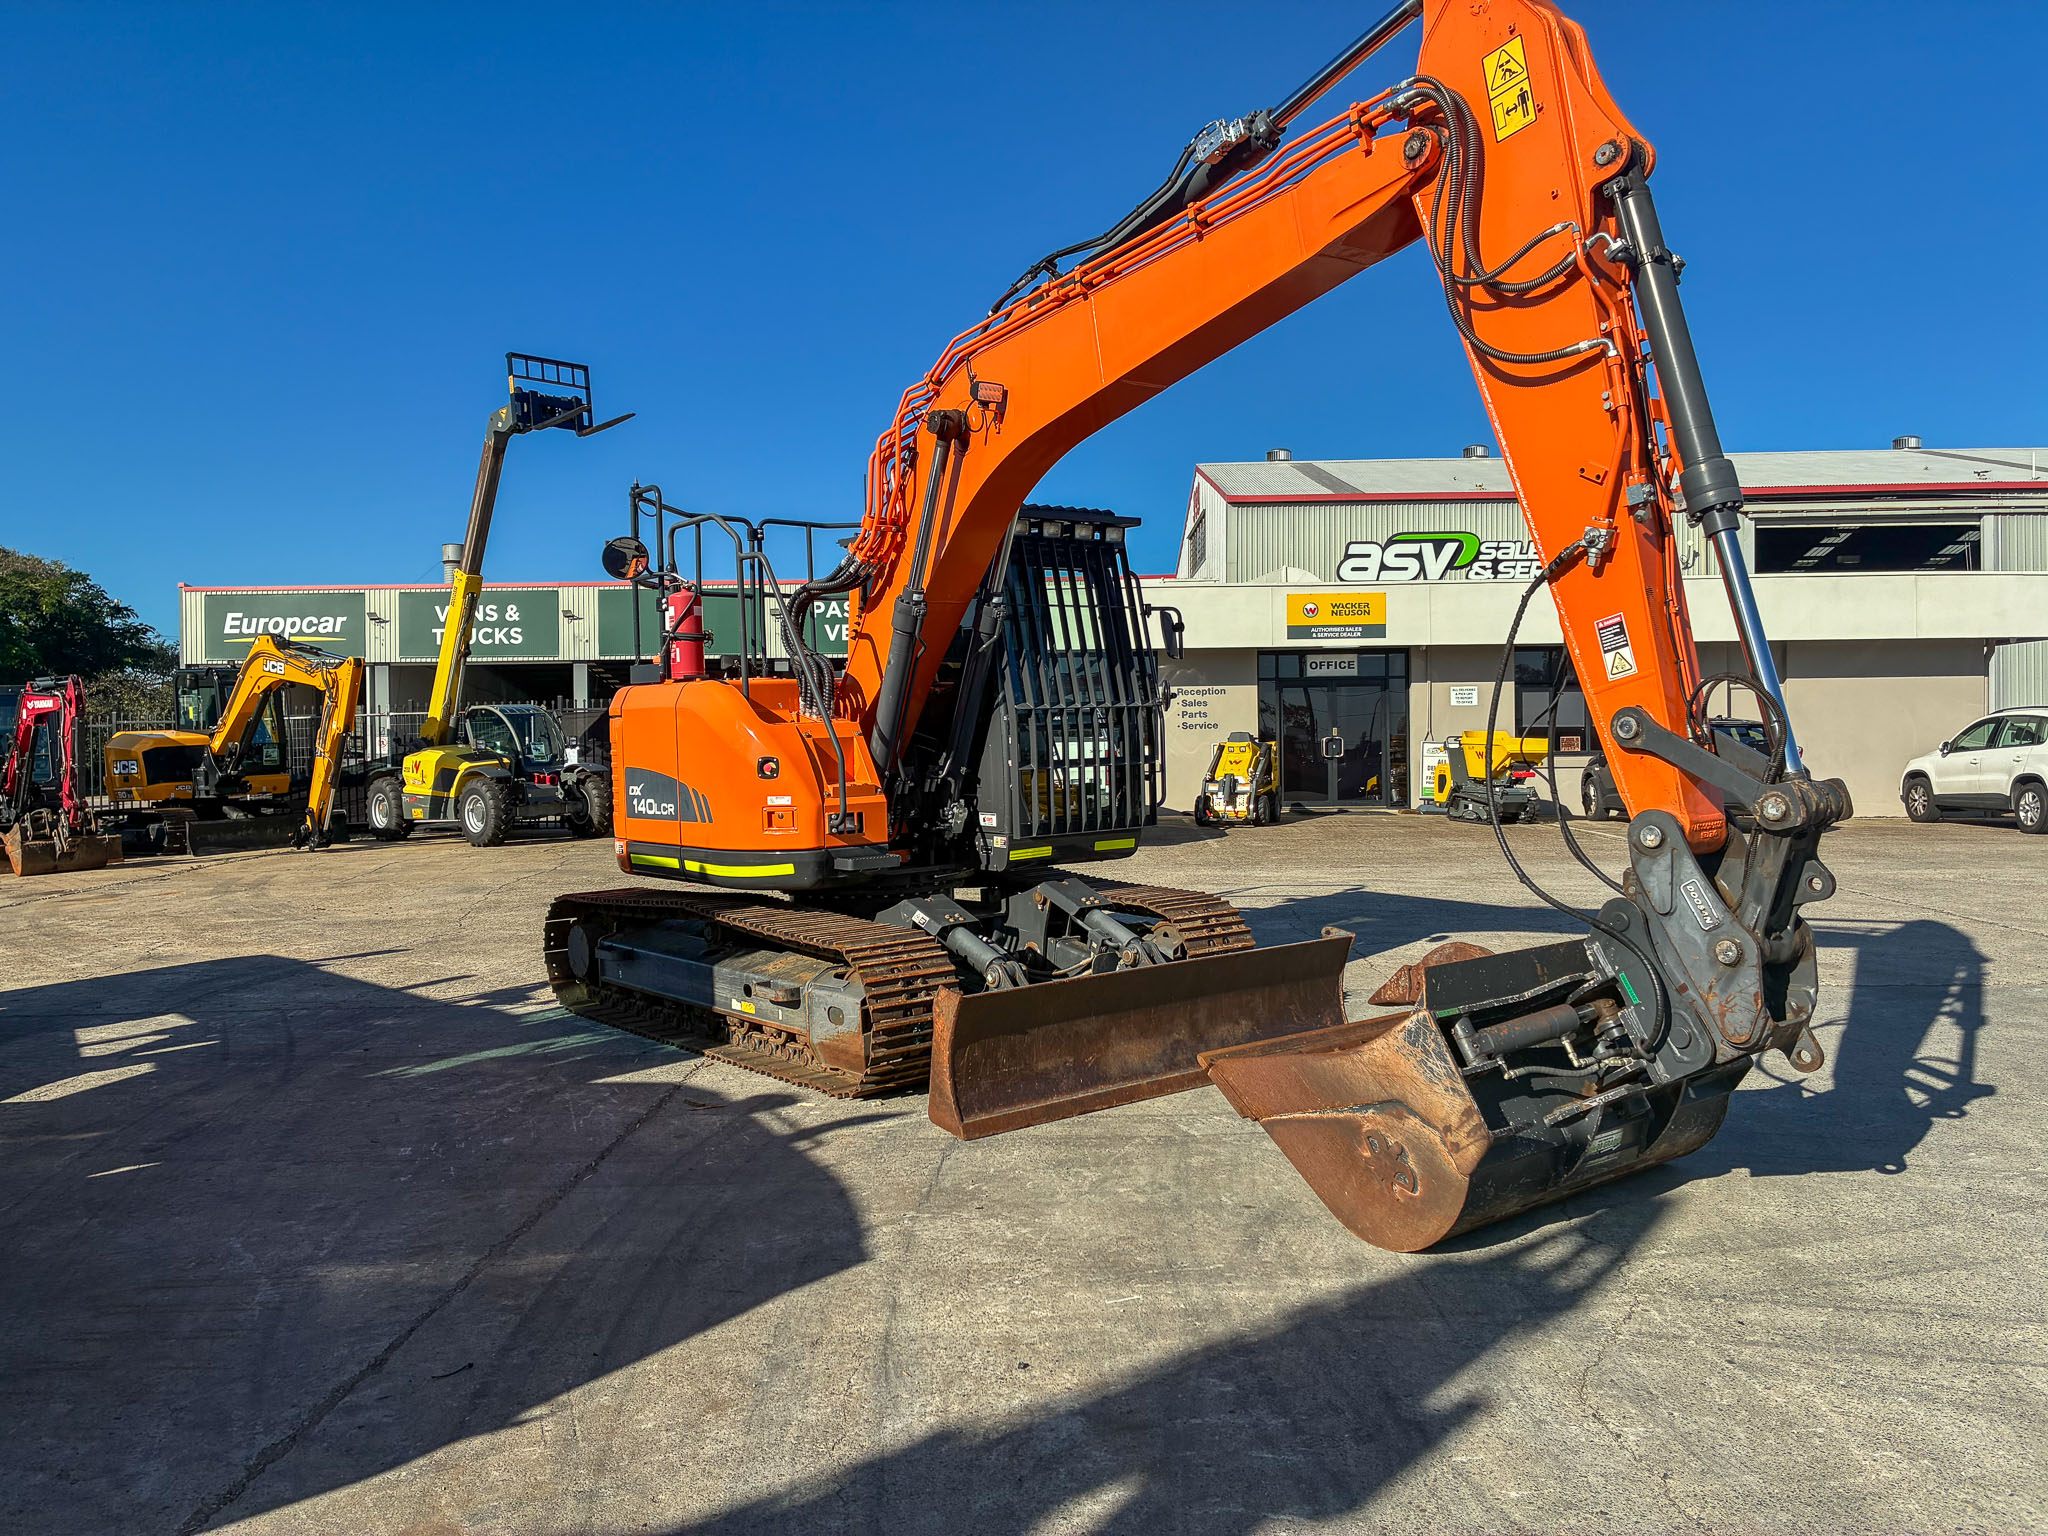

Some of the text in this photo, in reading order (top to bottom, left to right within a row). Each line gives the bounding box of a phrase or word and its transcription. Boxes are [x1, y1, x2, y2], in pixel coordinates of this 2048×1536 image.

[1467, 561, 1544, 579] & SER
[434, 604, 520, 623] VNS &
[813, 600, 850, 618] PAS
[1330, 602, 1370, 610] WACKER
[223, 612, 348, 641] Europcar
[824, 624, 849, 641] VE
[431, 627, 523, 645] TUCKS
[263, 658, 286, 675] JCB
[1309, 661, 1356, 670] OFFICE
[1176, 687, 1227, 697] Reception
[1181, 699, 1208, 708] Sales
[1181, 710, 1208, 719] Parts
[1181, 722, 1219, 730] Service
[113, 760, 138, 775] JCB
[628, 783, 645, 796] DX
[632, 797, 675, 816] 140LCR
[1686, 884, 1714, 925] DOOSAN
